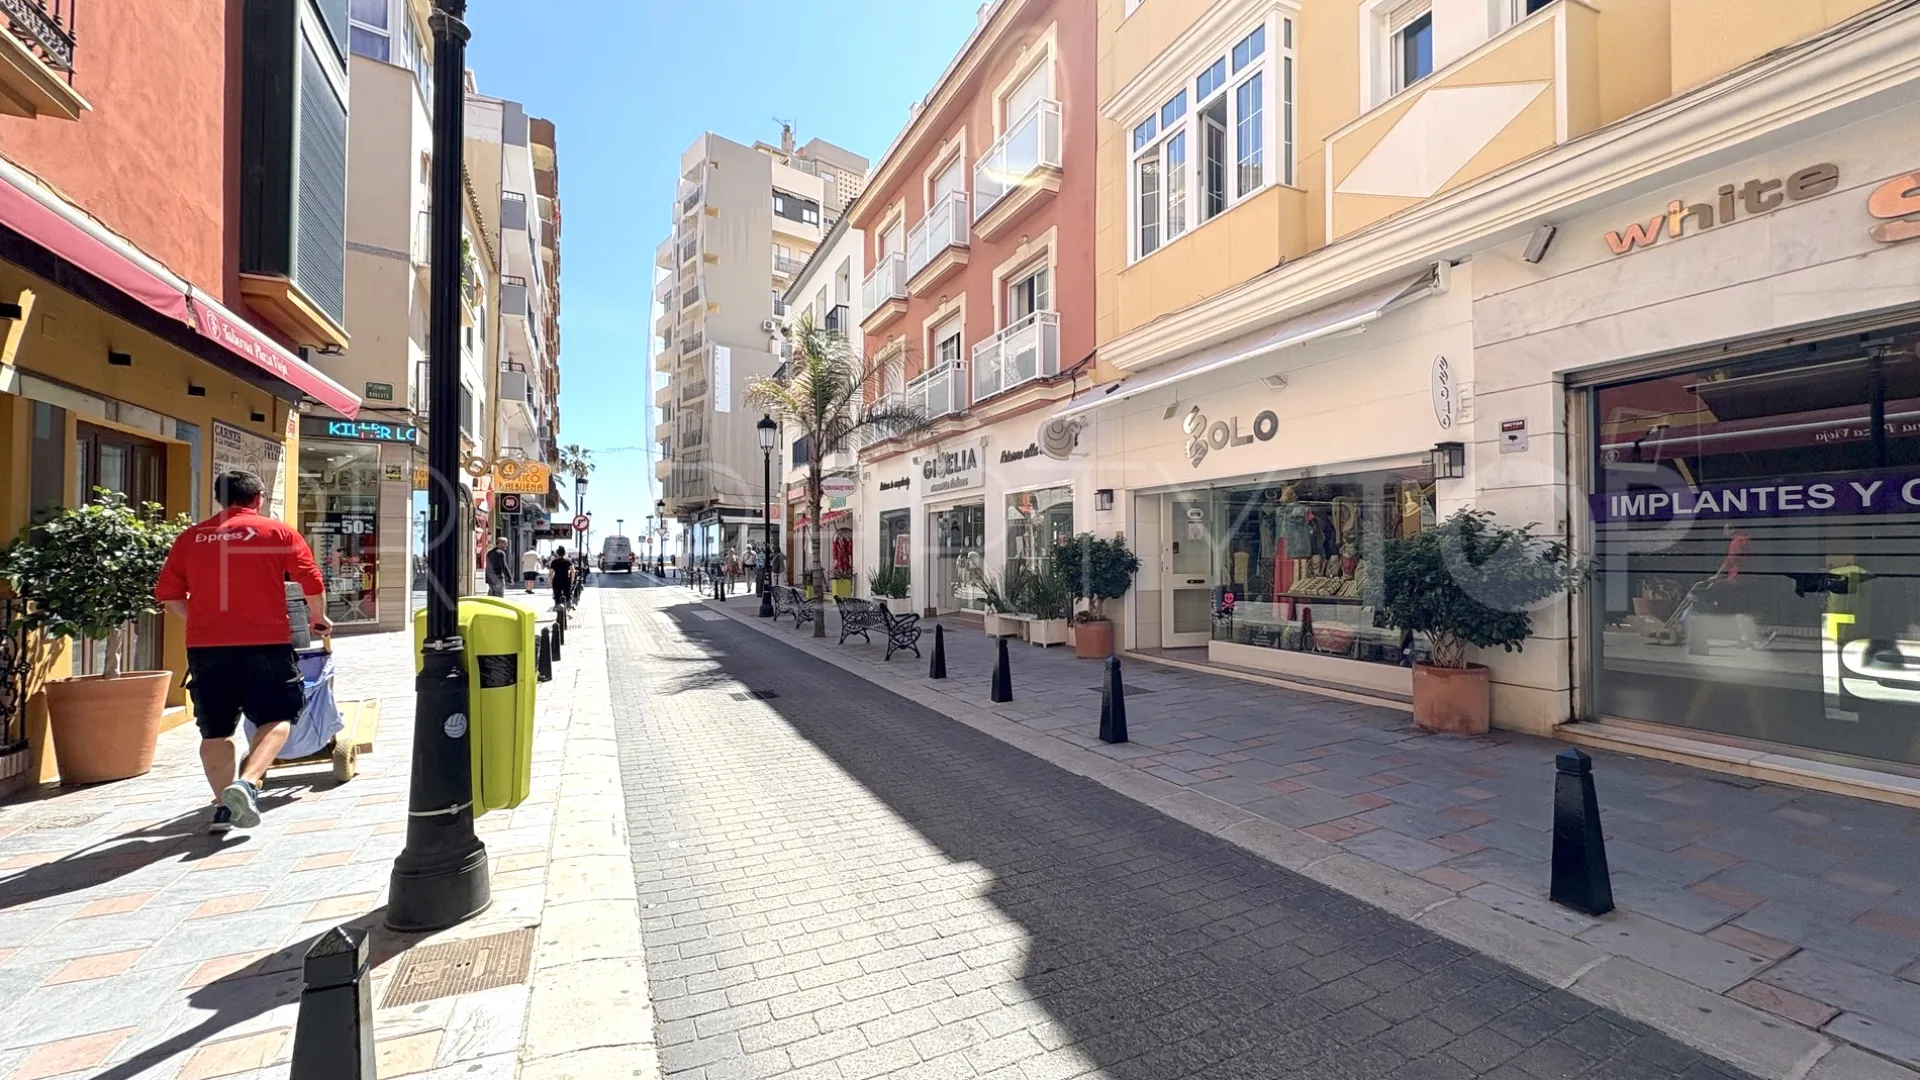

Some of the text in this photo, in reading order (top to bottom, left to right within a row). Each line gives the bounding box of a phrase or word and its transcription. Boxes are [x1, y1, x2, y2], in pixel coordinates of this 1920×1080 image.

[1604, 163, 1839, 255] white
[222, 323, 253, 355] Taberna
[254, 342, 274, 367] Plaza
[214, 424, 241, 443] CARNES
[1611, 480, 1836, 517] IMPLANTES
[1850, 481, 1884, 508] Y
[195, 531, 243, 543] Express
